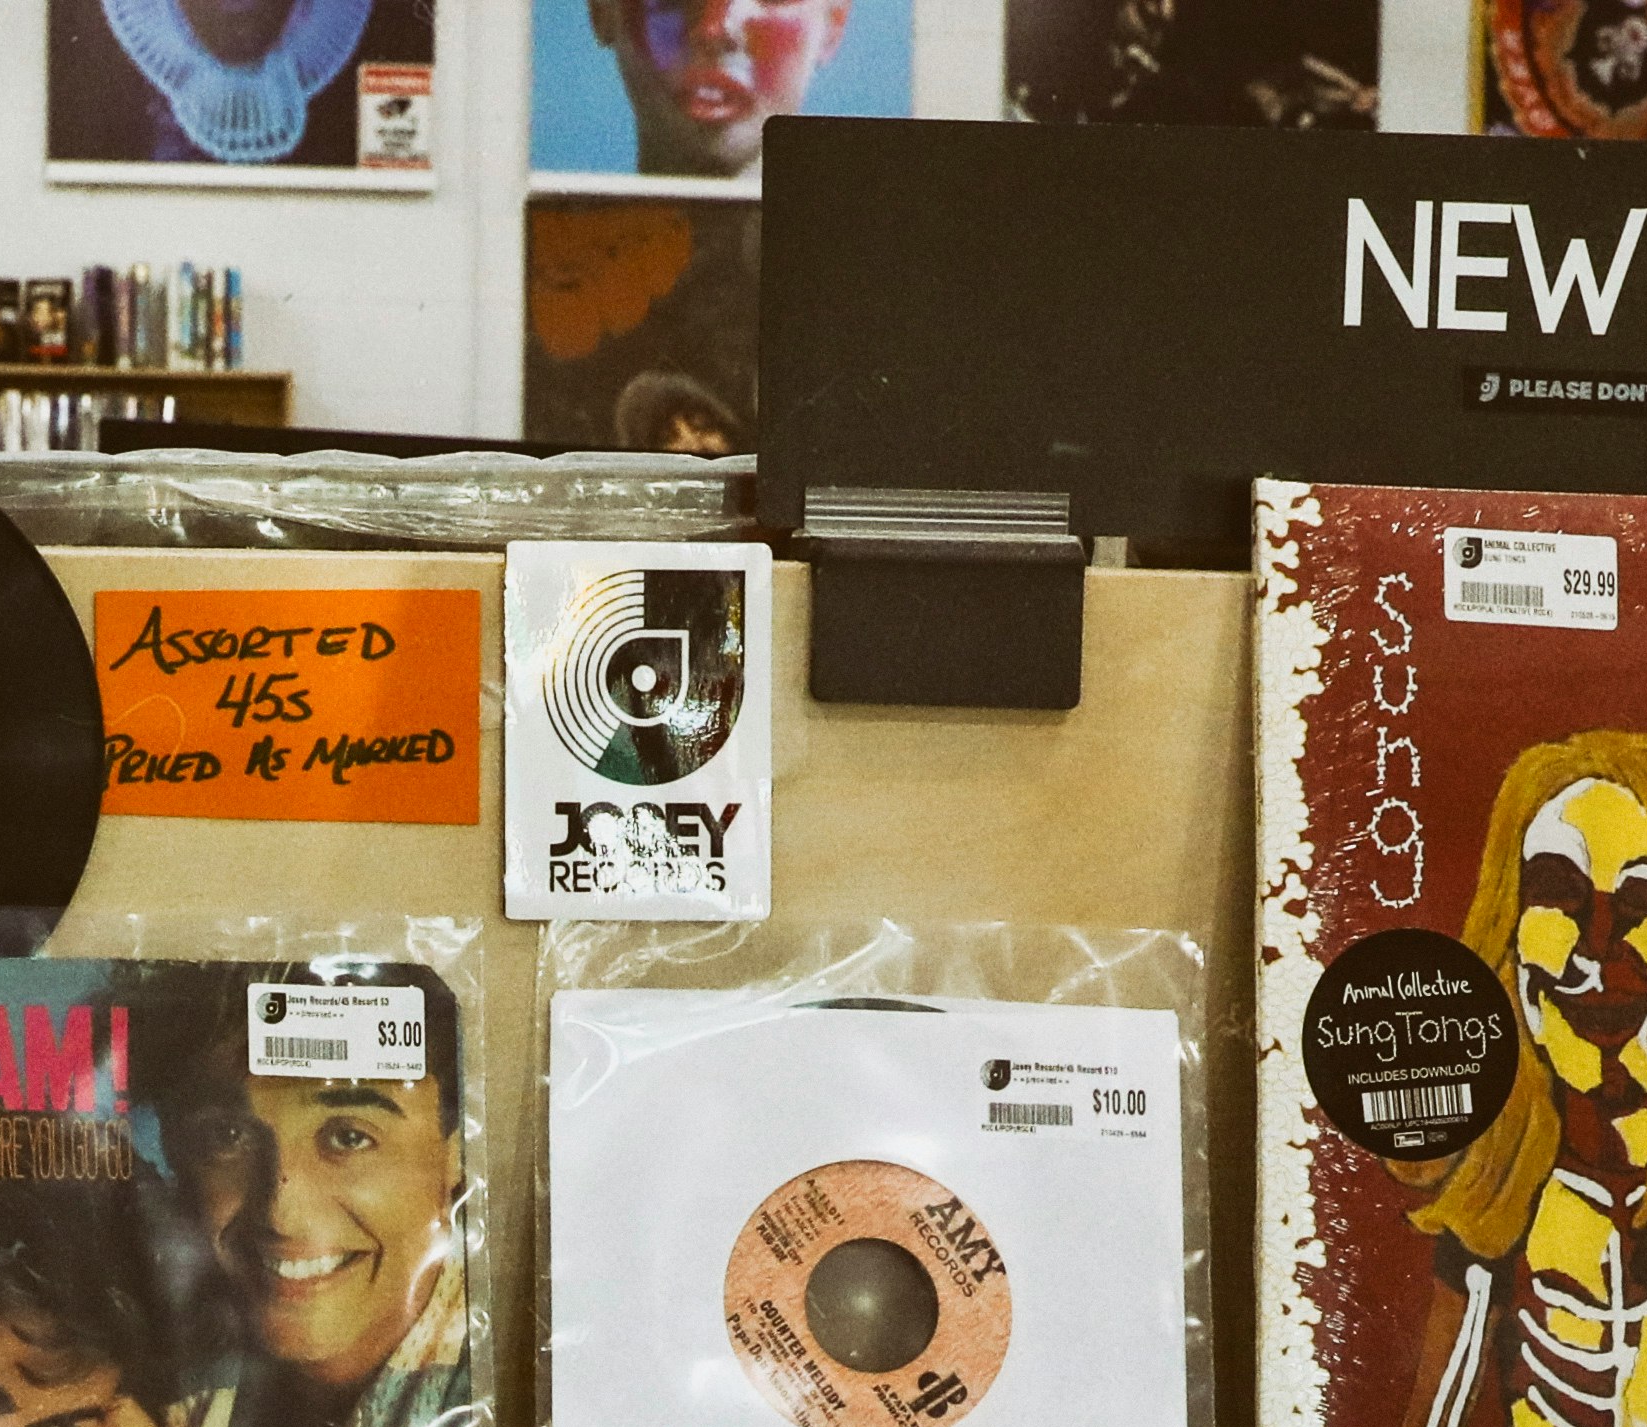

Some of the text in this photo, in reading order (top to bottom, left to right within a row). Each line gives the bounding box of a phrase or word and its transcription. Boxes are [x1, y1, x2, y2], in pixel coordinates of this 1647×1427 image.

[1509, 377, 1592, 401] PLEASE
[1563, 569, 1615, 597] $29.99
[109, 605, 396, 674] ASSORTED
[215, 673, 314, 728] 45s
[1343, 969, 1472, 1004] Animal Collective
[378, 1020, 421, 1047] $3.00
[1348, 1063, 1481, 1085] INCLUDES DOWNLOAD
[1093, 1089, 1146, 1116] $10.00
[909, 1211, 976, 1298] RECORDS
[925, 1195, 1007, 1284] AMY
[759, 1299, 808, 1361] COUNTER
[803, 1359, 847, 1411] MELODY
